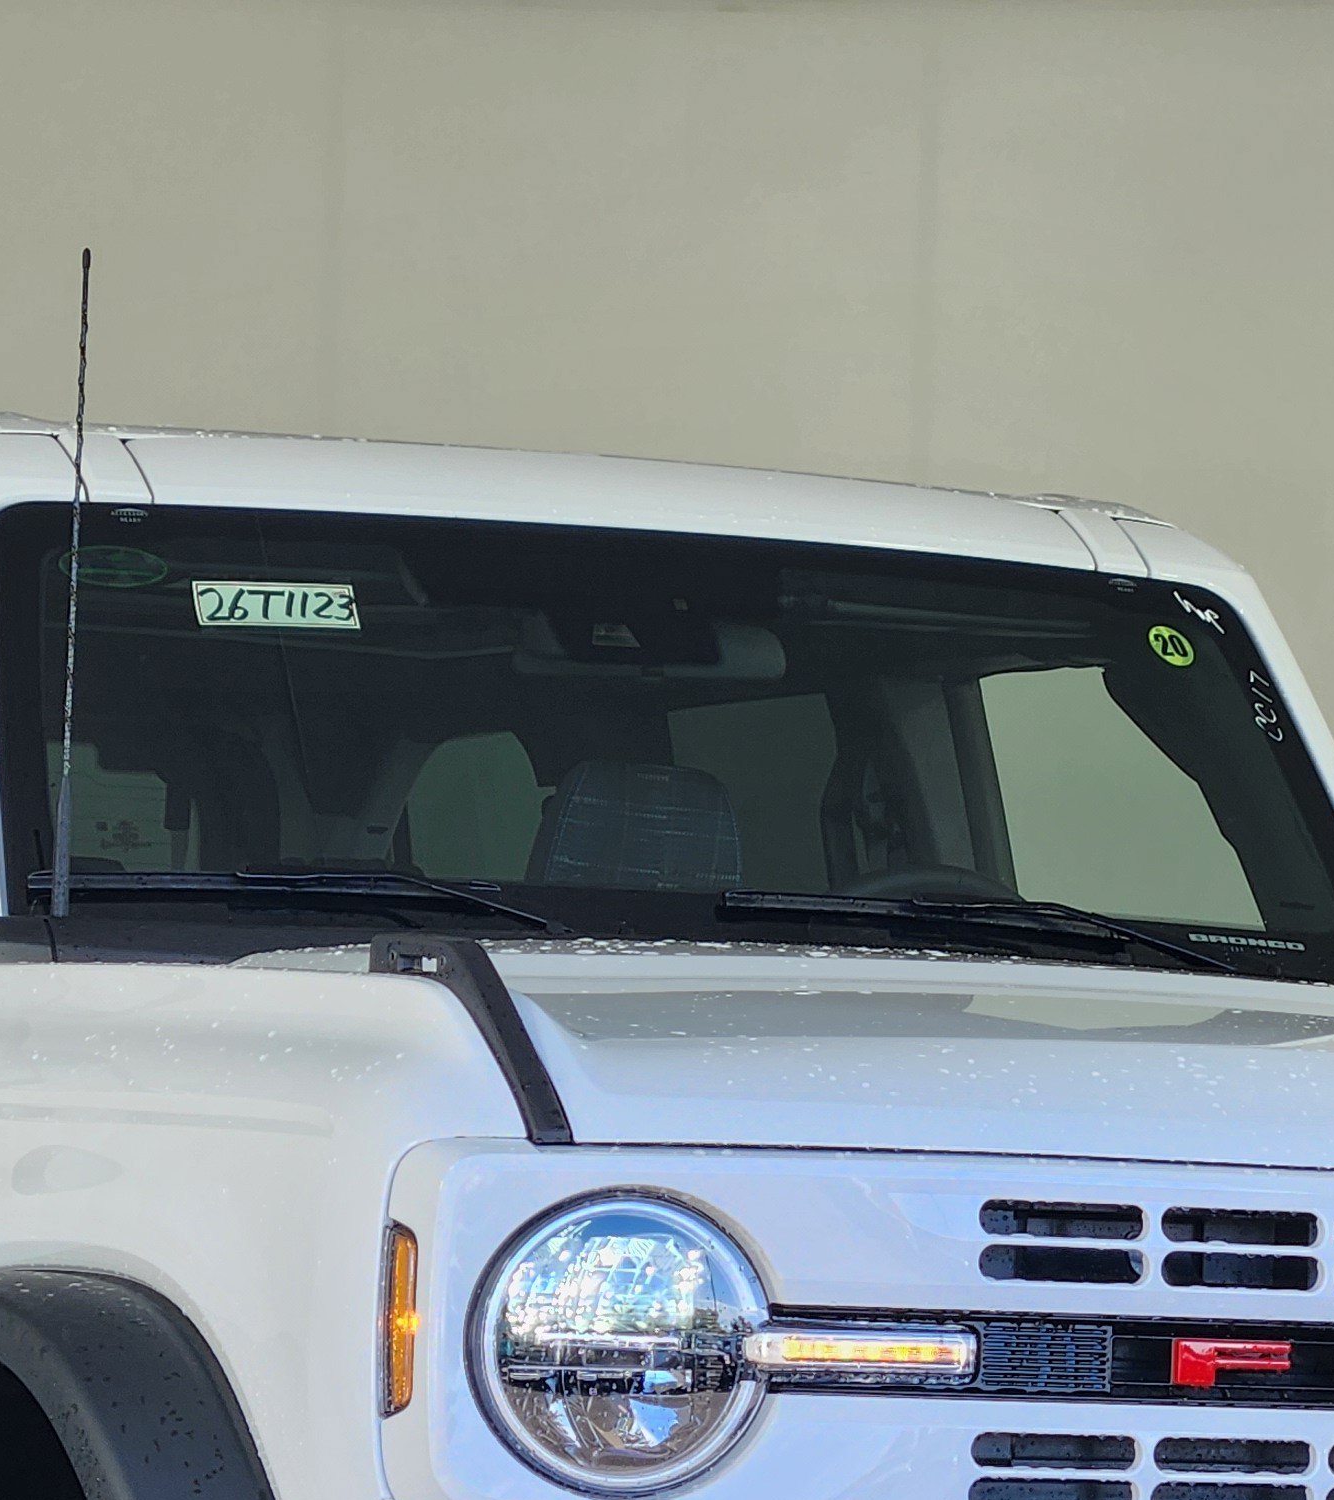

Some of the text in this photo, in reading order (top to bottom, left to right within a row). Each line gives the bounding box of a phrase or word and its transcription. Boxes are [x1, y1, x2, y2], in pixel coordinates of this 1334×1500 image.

[199, 587, 356, 621] 26T1123
[1154, 633, 1189, 657] 20
[1188, 932, 1305, 952] BRONCO
